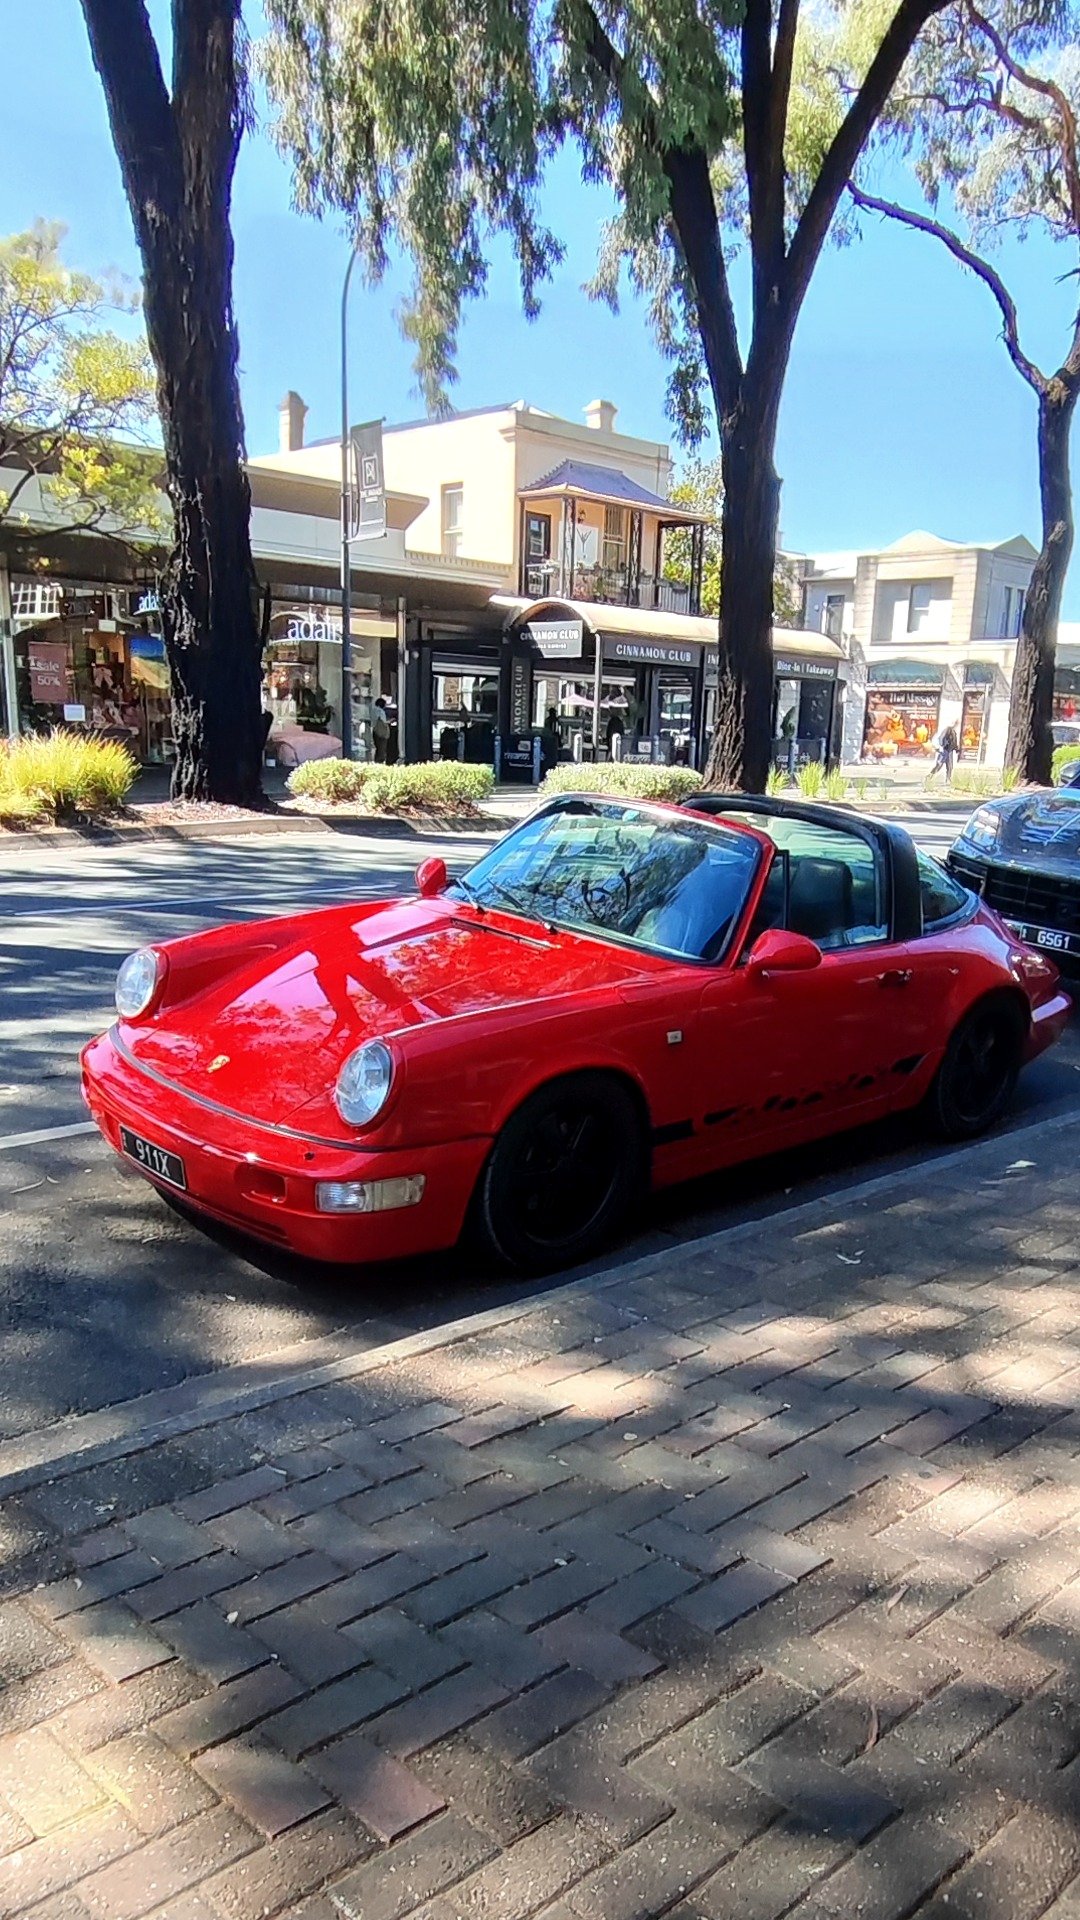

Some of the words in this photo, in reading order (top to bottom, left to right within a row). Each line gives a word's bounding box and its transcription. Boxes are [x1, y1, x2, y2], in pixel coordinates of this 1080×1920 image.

[559, 629, 579, 640] CLUB
[616, 644, 666, 660] CINNAMON
[668, 650, 691, 662] CLUB
[1037, 930, 1070, 950] GSG1
[135, 1139, 171, 1177] 911X
